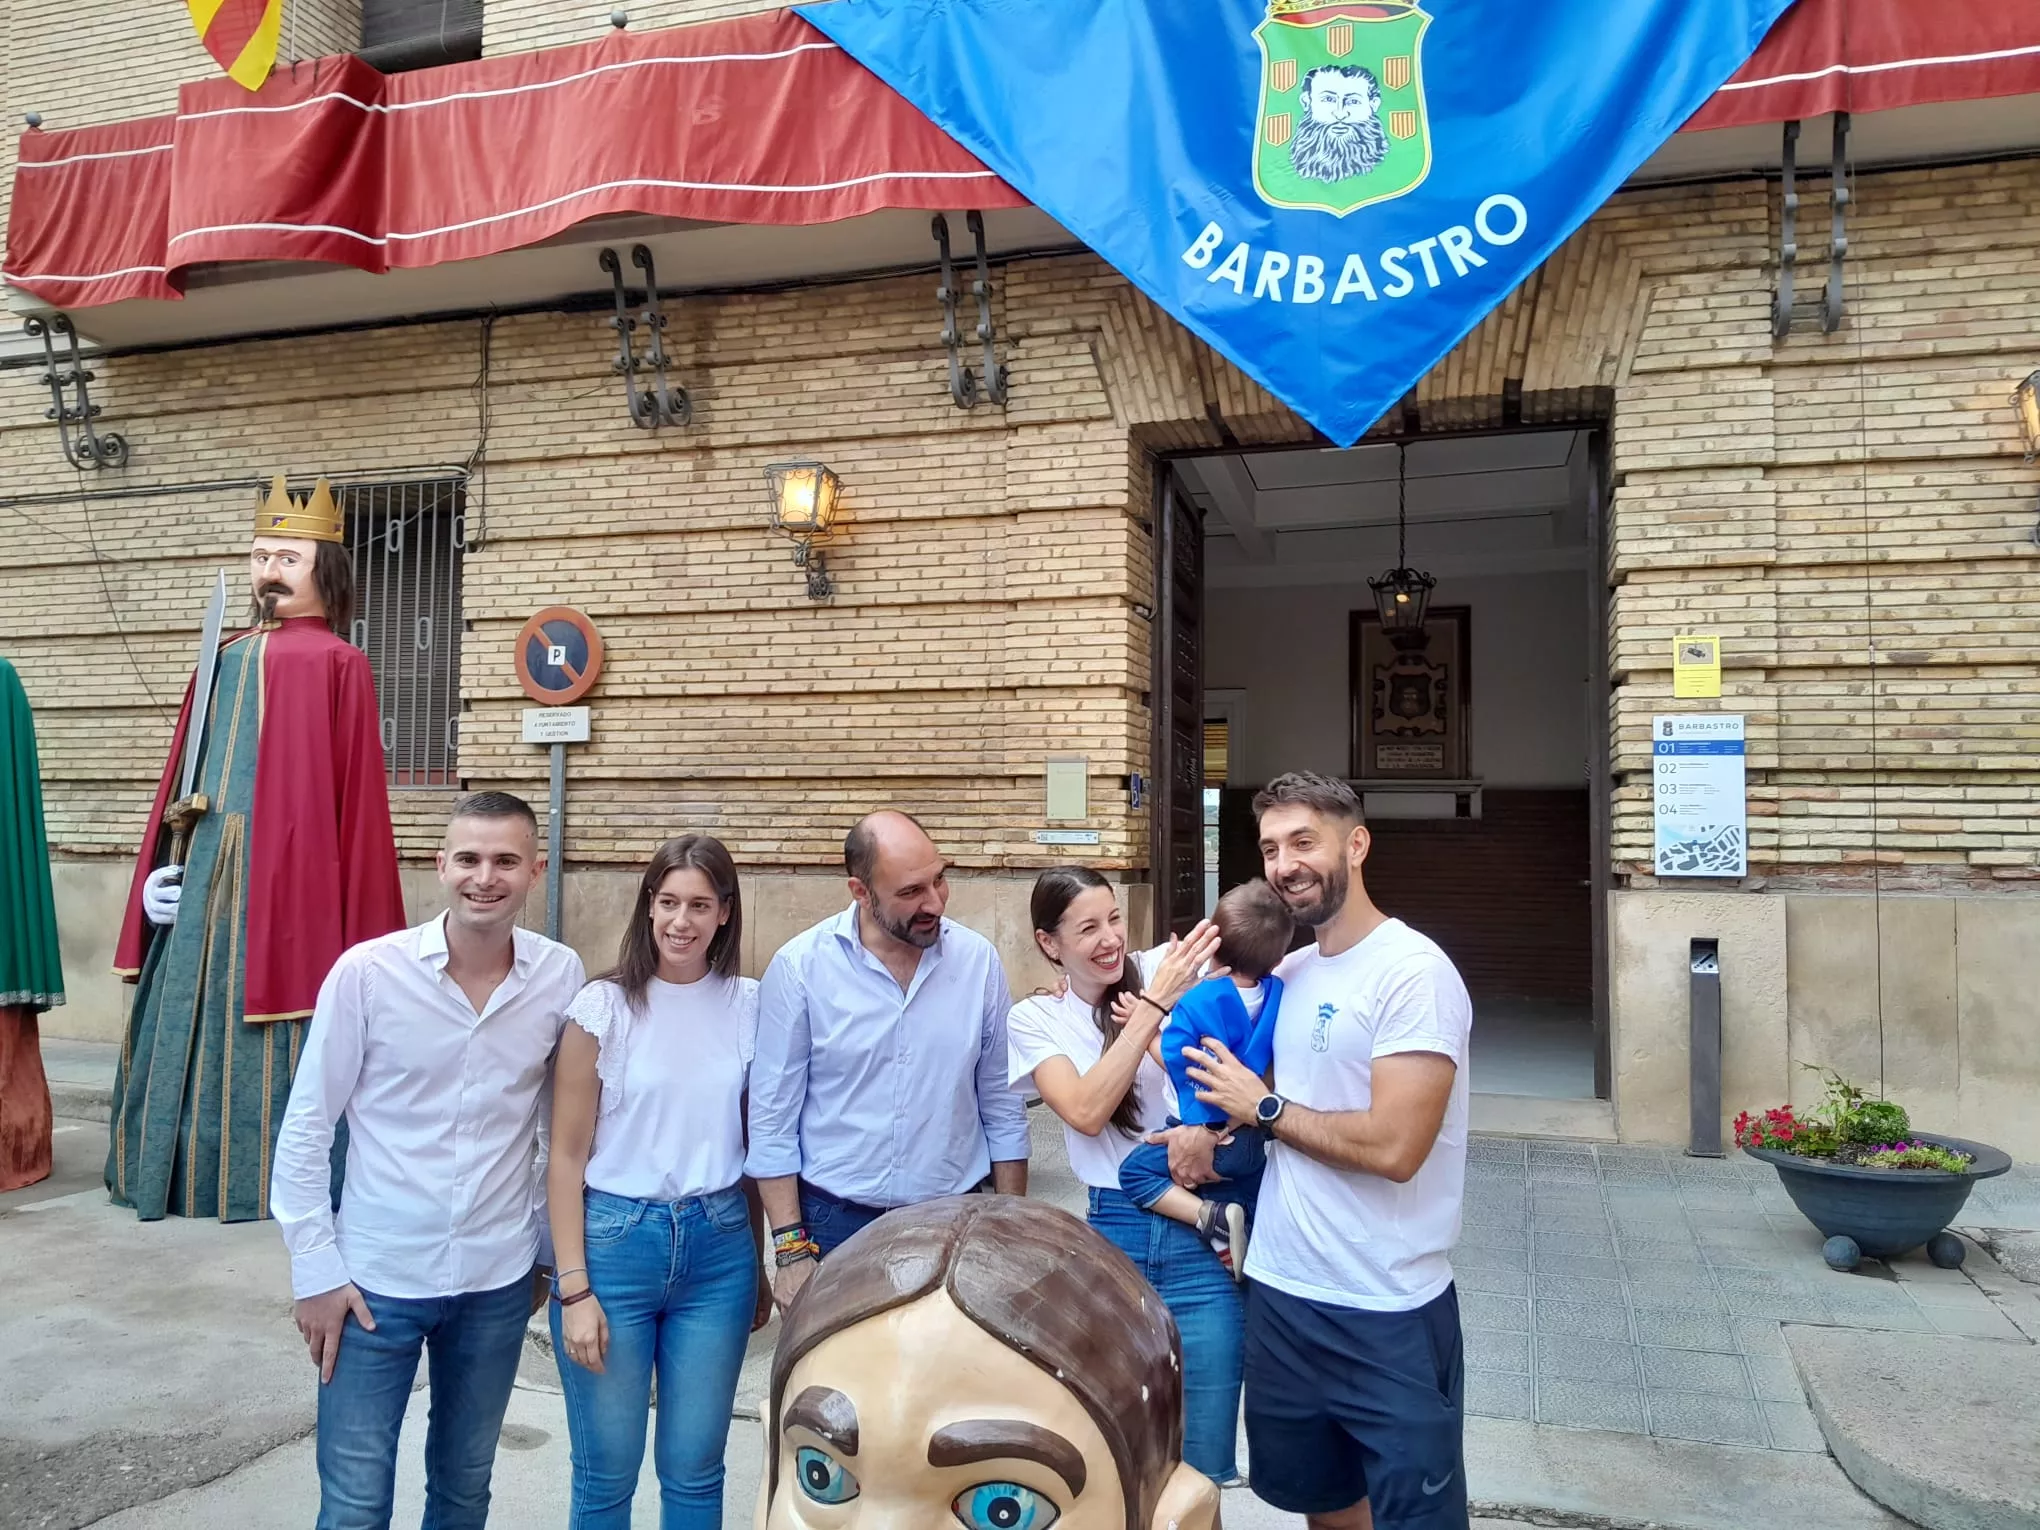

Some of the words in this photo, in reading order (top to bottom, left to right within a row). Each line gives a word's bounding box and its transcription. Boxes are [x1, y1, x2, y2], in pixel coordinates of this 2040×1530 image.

[1181, 193, 1528, 304] BARBASTRO
[553, 648, 561, 662] P
[1678, 722, 1739, 730] BARBASTRO
[1658, 742, 1675, 753] 01
[1658, 762, 1677, 774] 02
[1658, 783, 1677, 795] 03
[1658, 804, 1677, 815] 04
